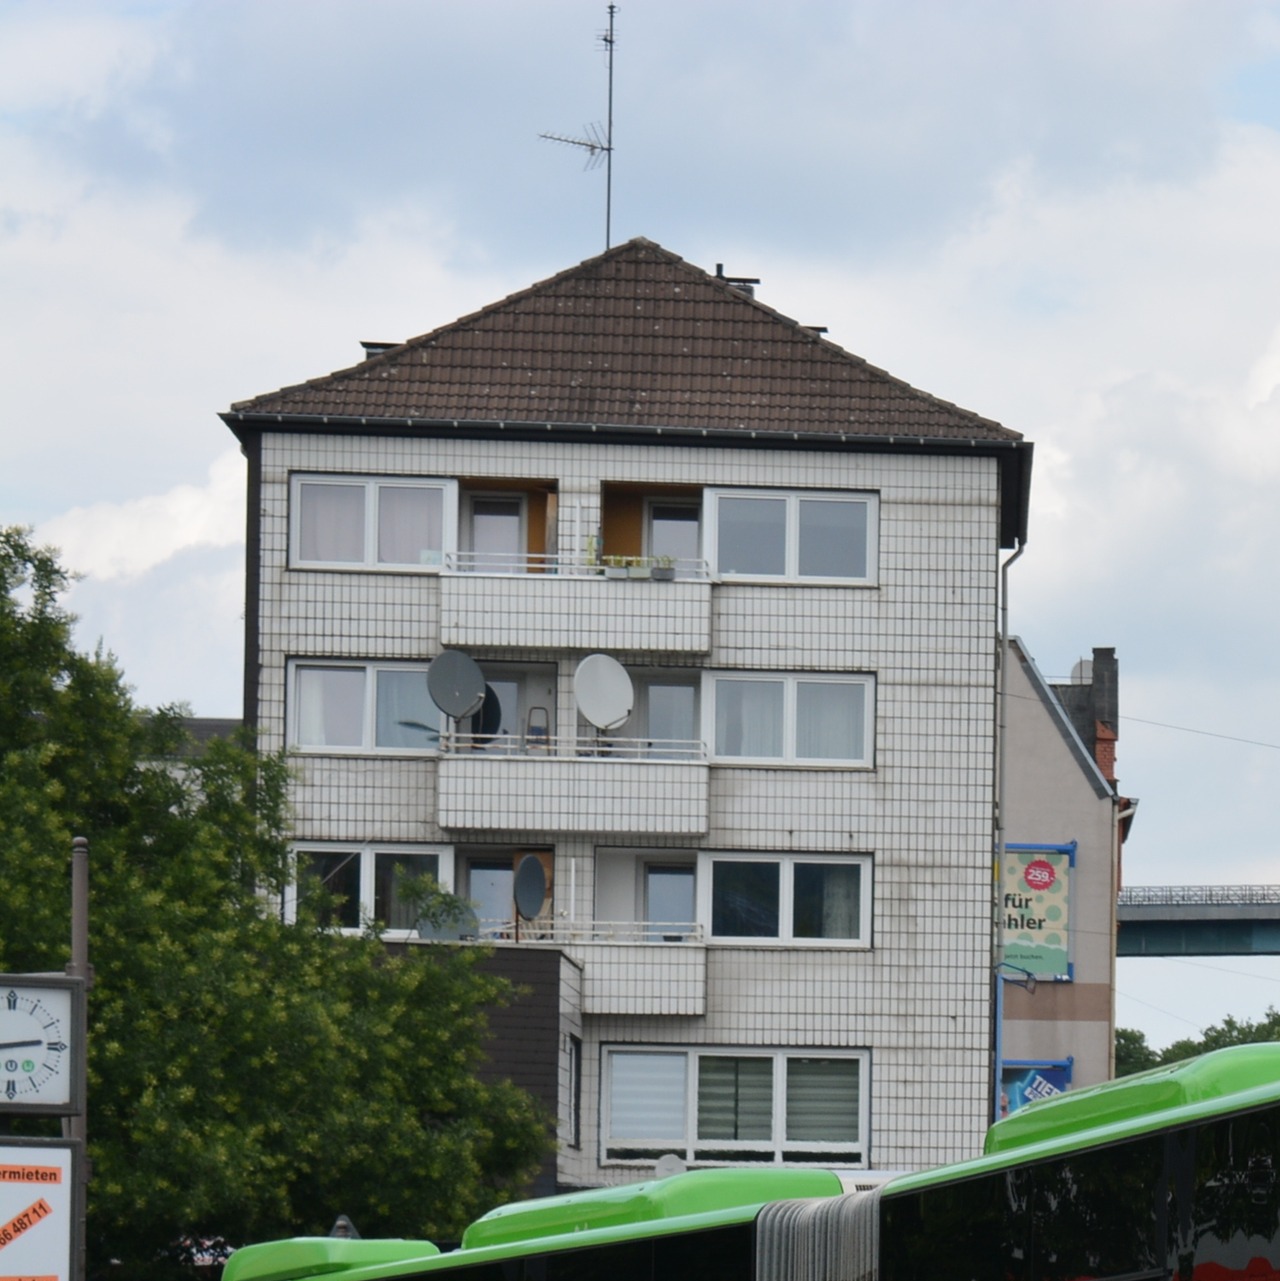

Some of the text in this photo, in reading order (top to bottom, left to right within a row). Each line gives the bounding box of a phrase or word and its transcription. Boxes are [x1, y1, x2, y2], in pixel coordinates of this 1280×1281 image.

[1004, 893, 1033, 909] für
[12, 1214, 33, 1233] 487
[32, 1202, 48, 1219] 11
